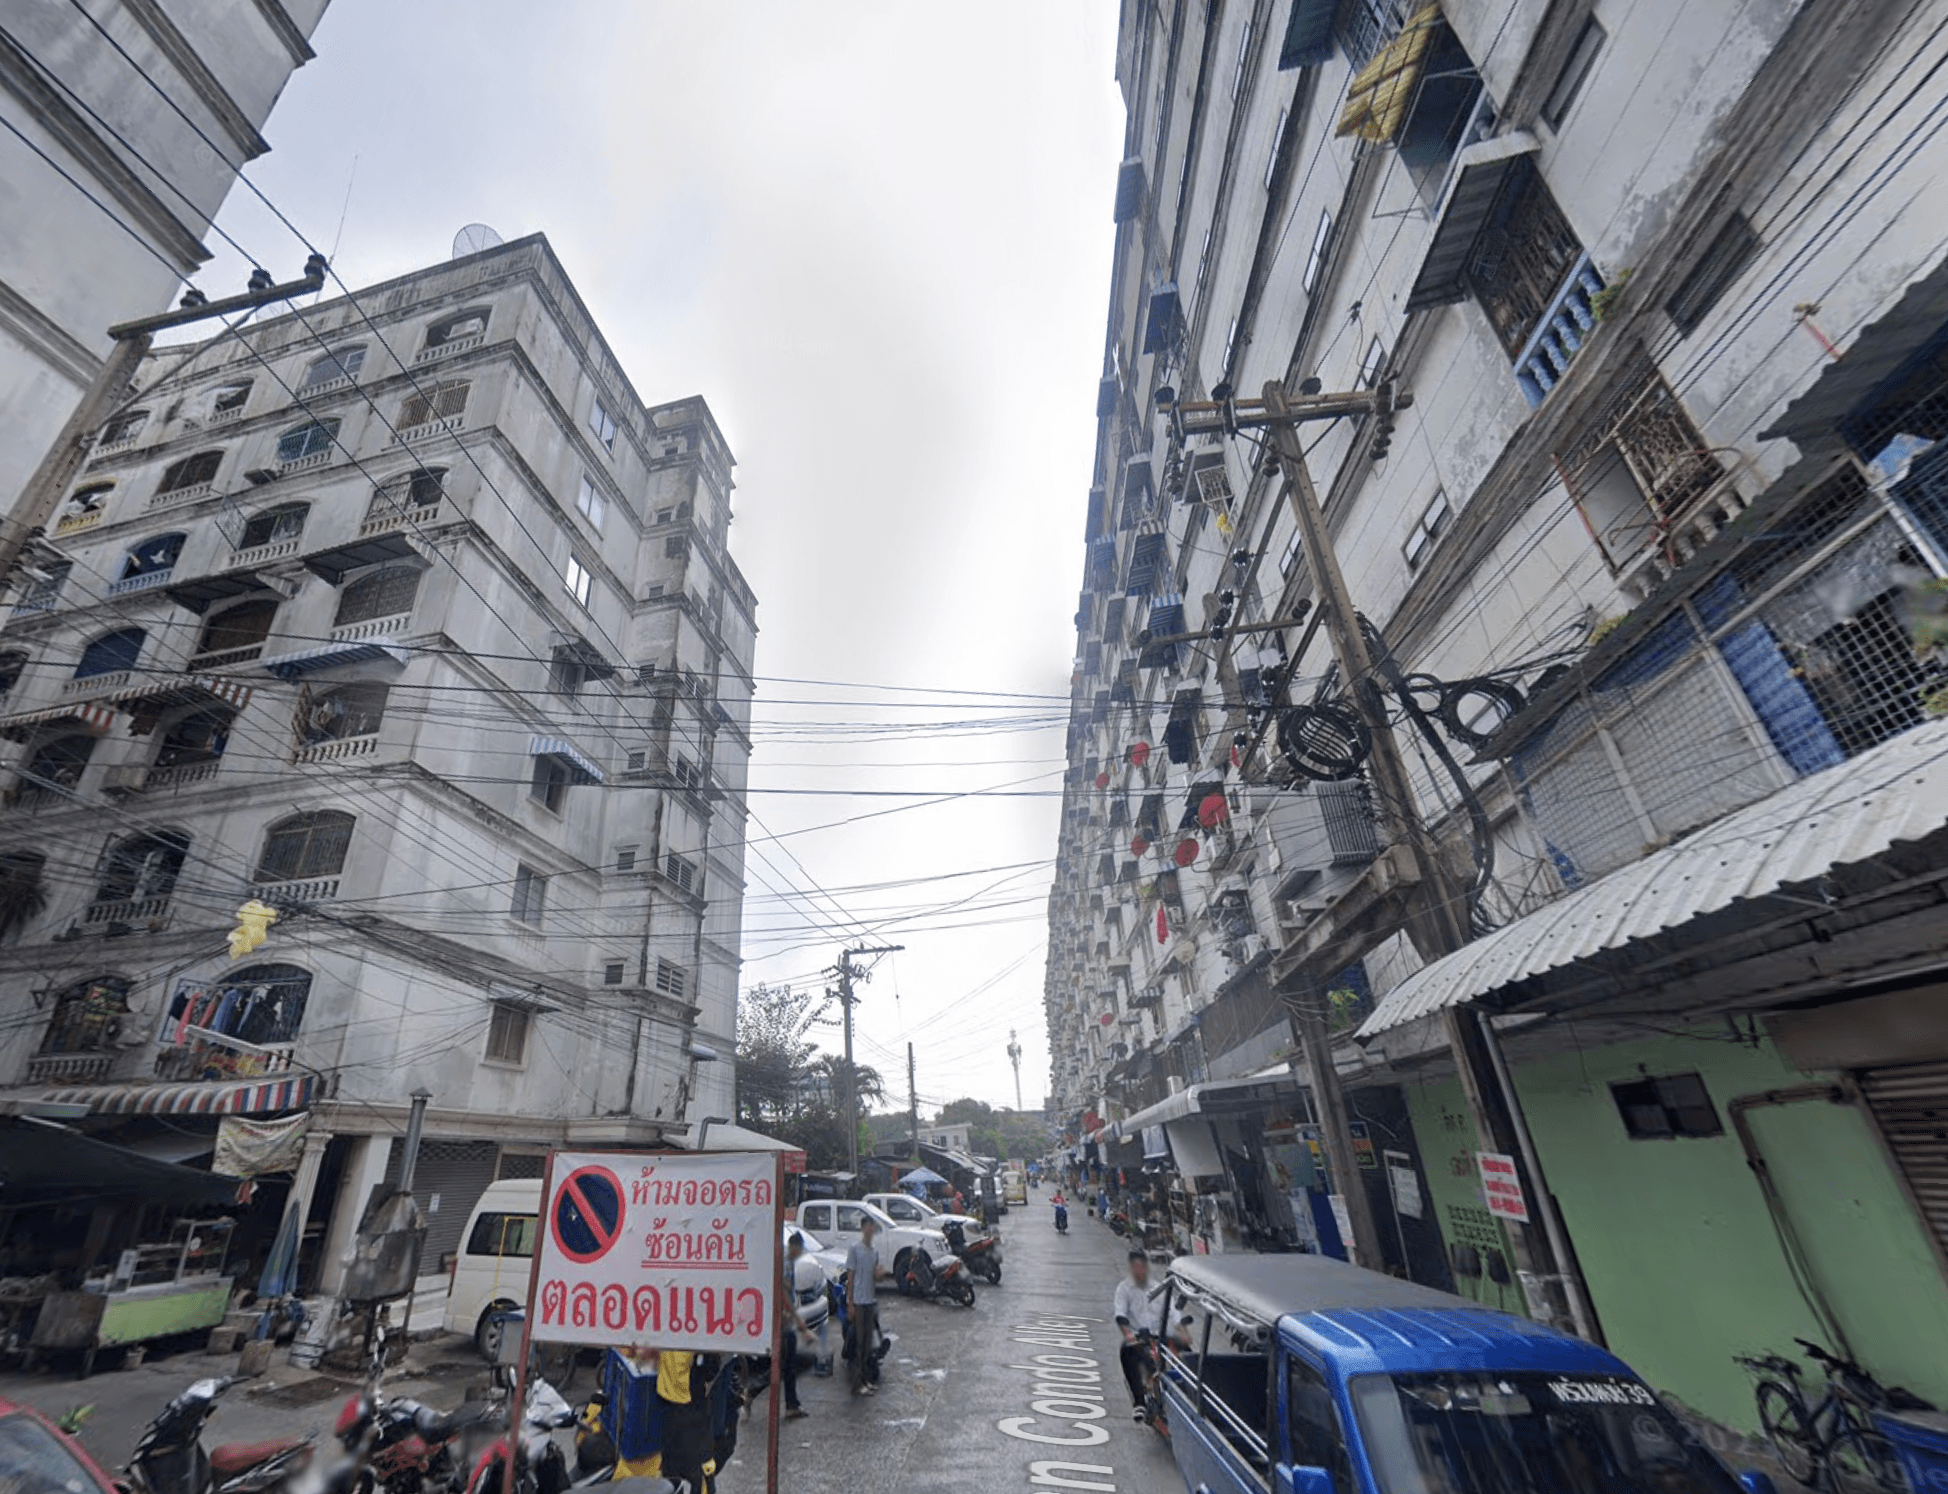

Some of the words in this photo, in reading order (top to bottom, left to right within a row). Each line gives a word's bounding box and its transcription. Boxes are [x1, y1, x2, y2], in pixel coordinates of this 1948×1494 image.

[632, 1166, 772, 1206] ห้ามจอดรถ
[645, 1217, 745, 1260] ซ้อนคัน
[541, 1279, 764, 1337] ตลอดแนว
